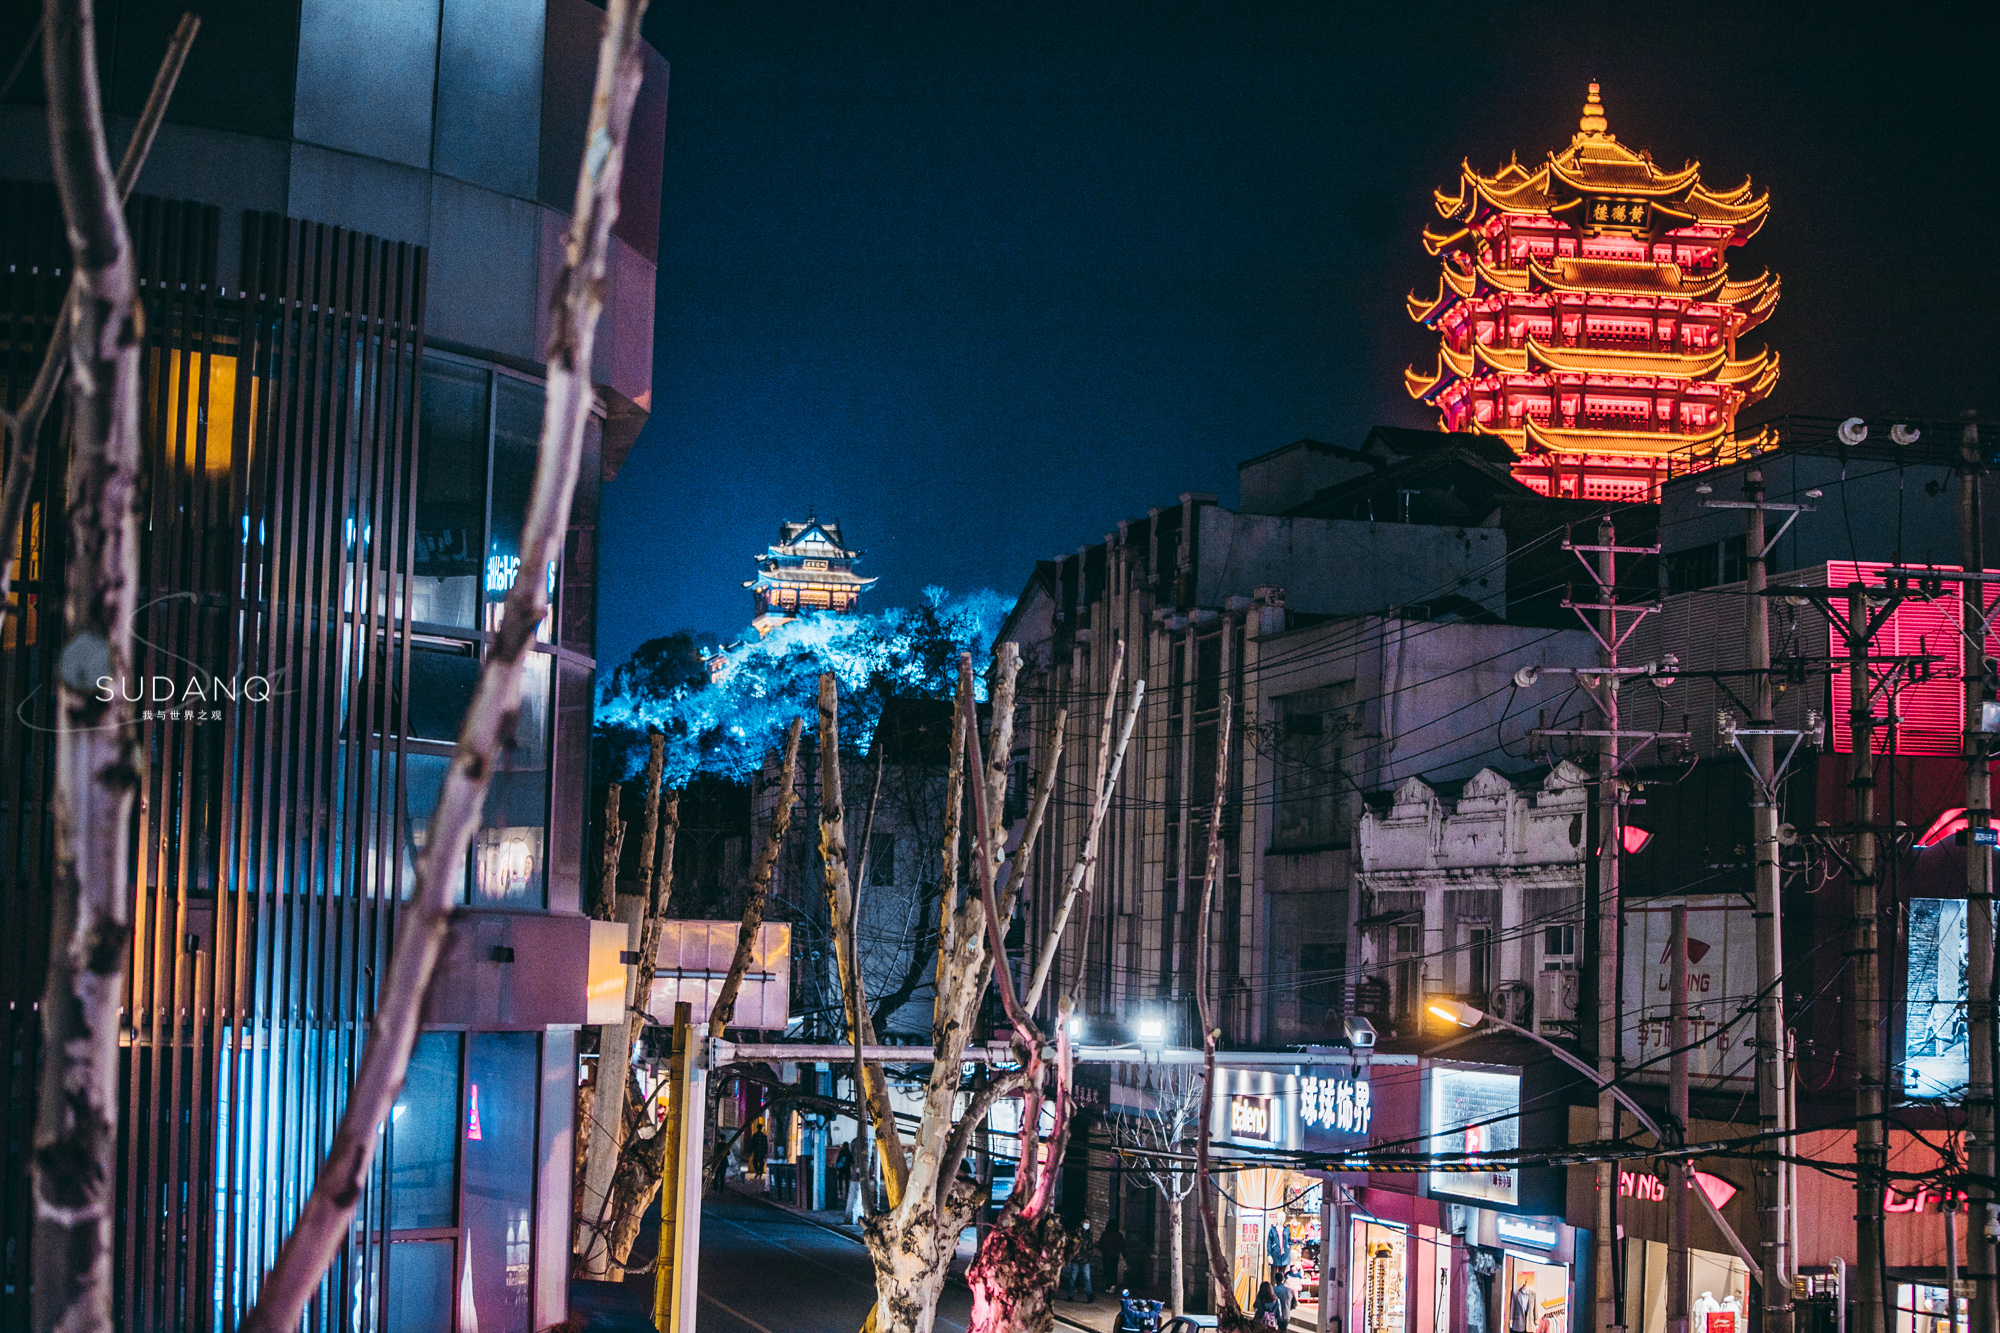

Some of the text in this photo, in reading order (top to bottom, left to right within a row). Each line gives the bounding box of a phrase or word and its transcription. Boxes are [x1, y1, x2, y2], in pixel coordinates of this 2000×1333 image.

[1231, 1098, 1267, 1135] Baleno
[1242, 1223, 1259, 1234] BIG
[1242, 1234, 1259, 1242] SALE
